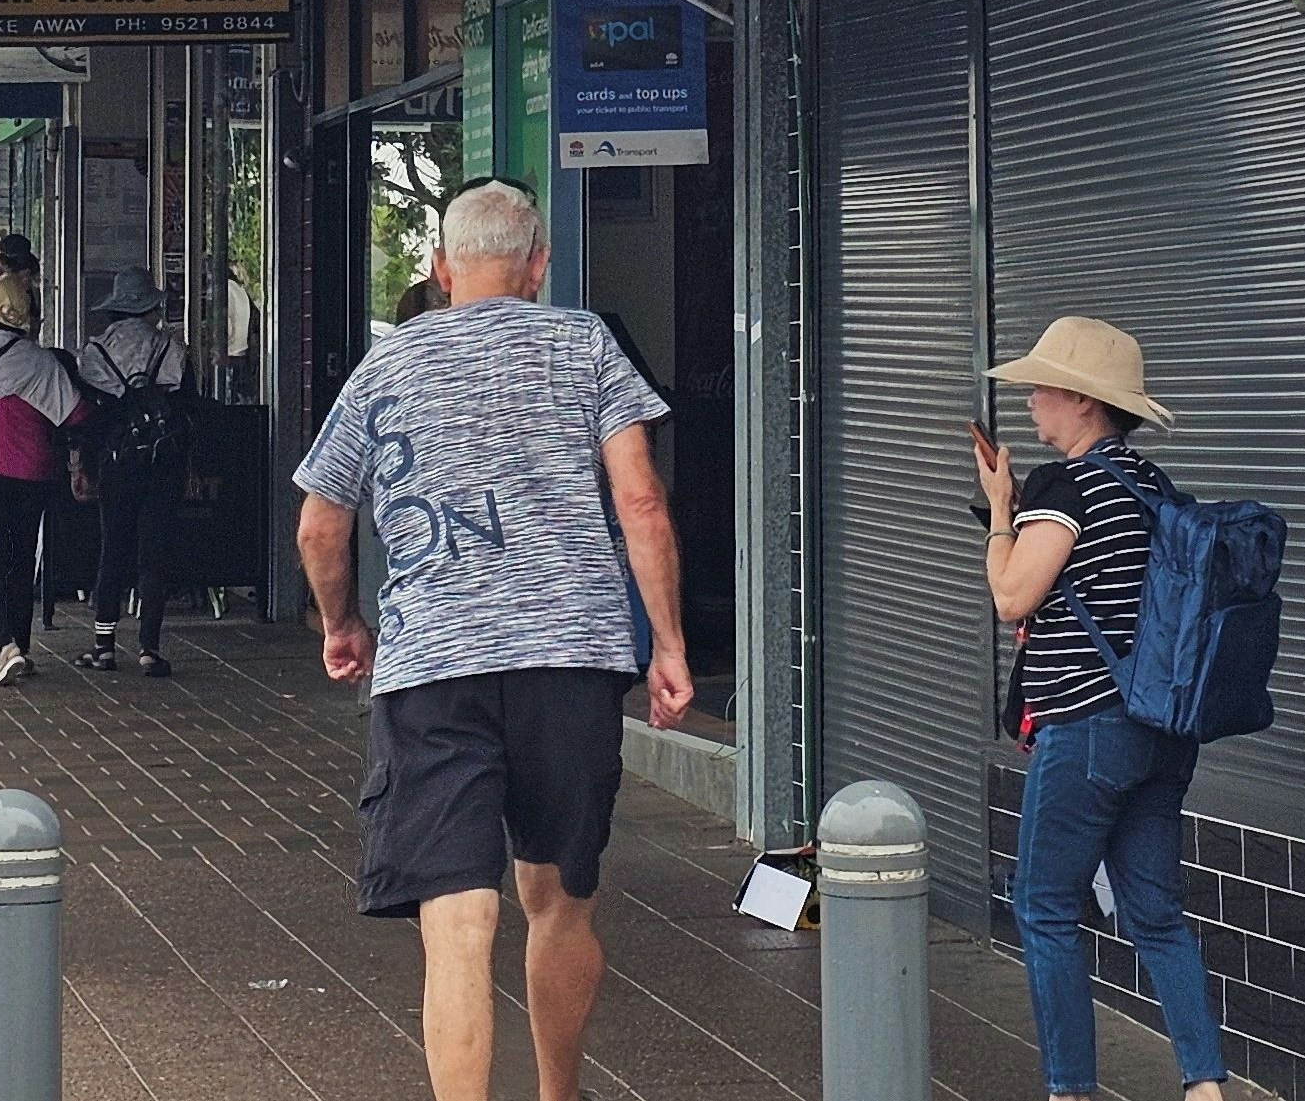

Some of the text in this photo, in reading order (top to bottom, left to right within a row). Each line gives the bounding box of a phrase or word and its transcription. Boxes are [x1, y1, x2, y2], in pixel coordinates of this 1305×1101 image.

[32, 17, 87, 33] AWAY
[114, 17, 147, 31] PH:
[160, 16, 209, 31] 9521
[222, 15, 276, 30] 8844
[576, 87, 616, 101] cards
[636, 87, 660, 101] top
[662, 87, 688, 101] ups
